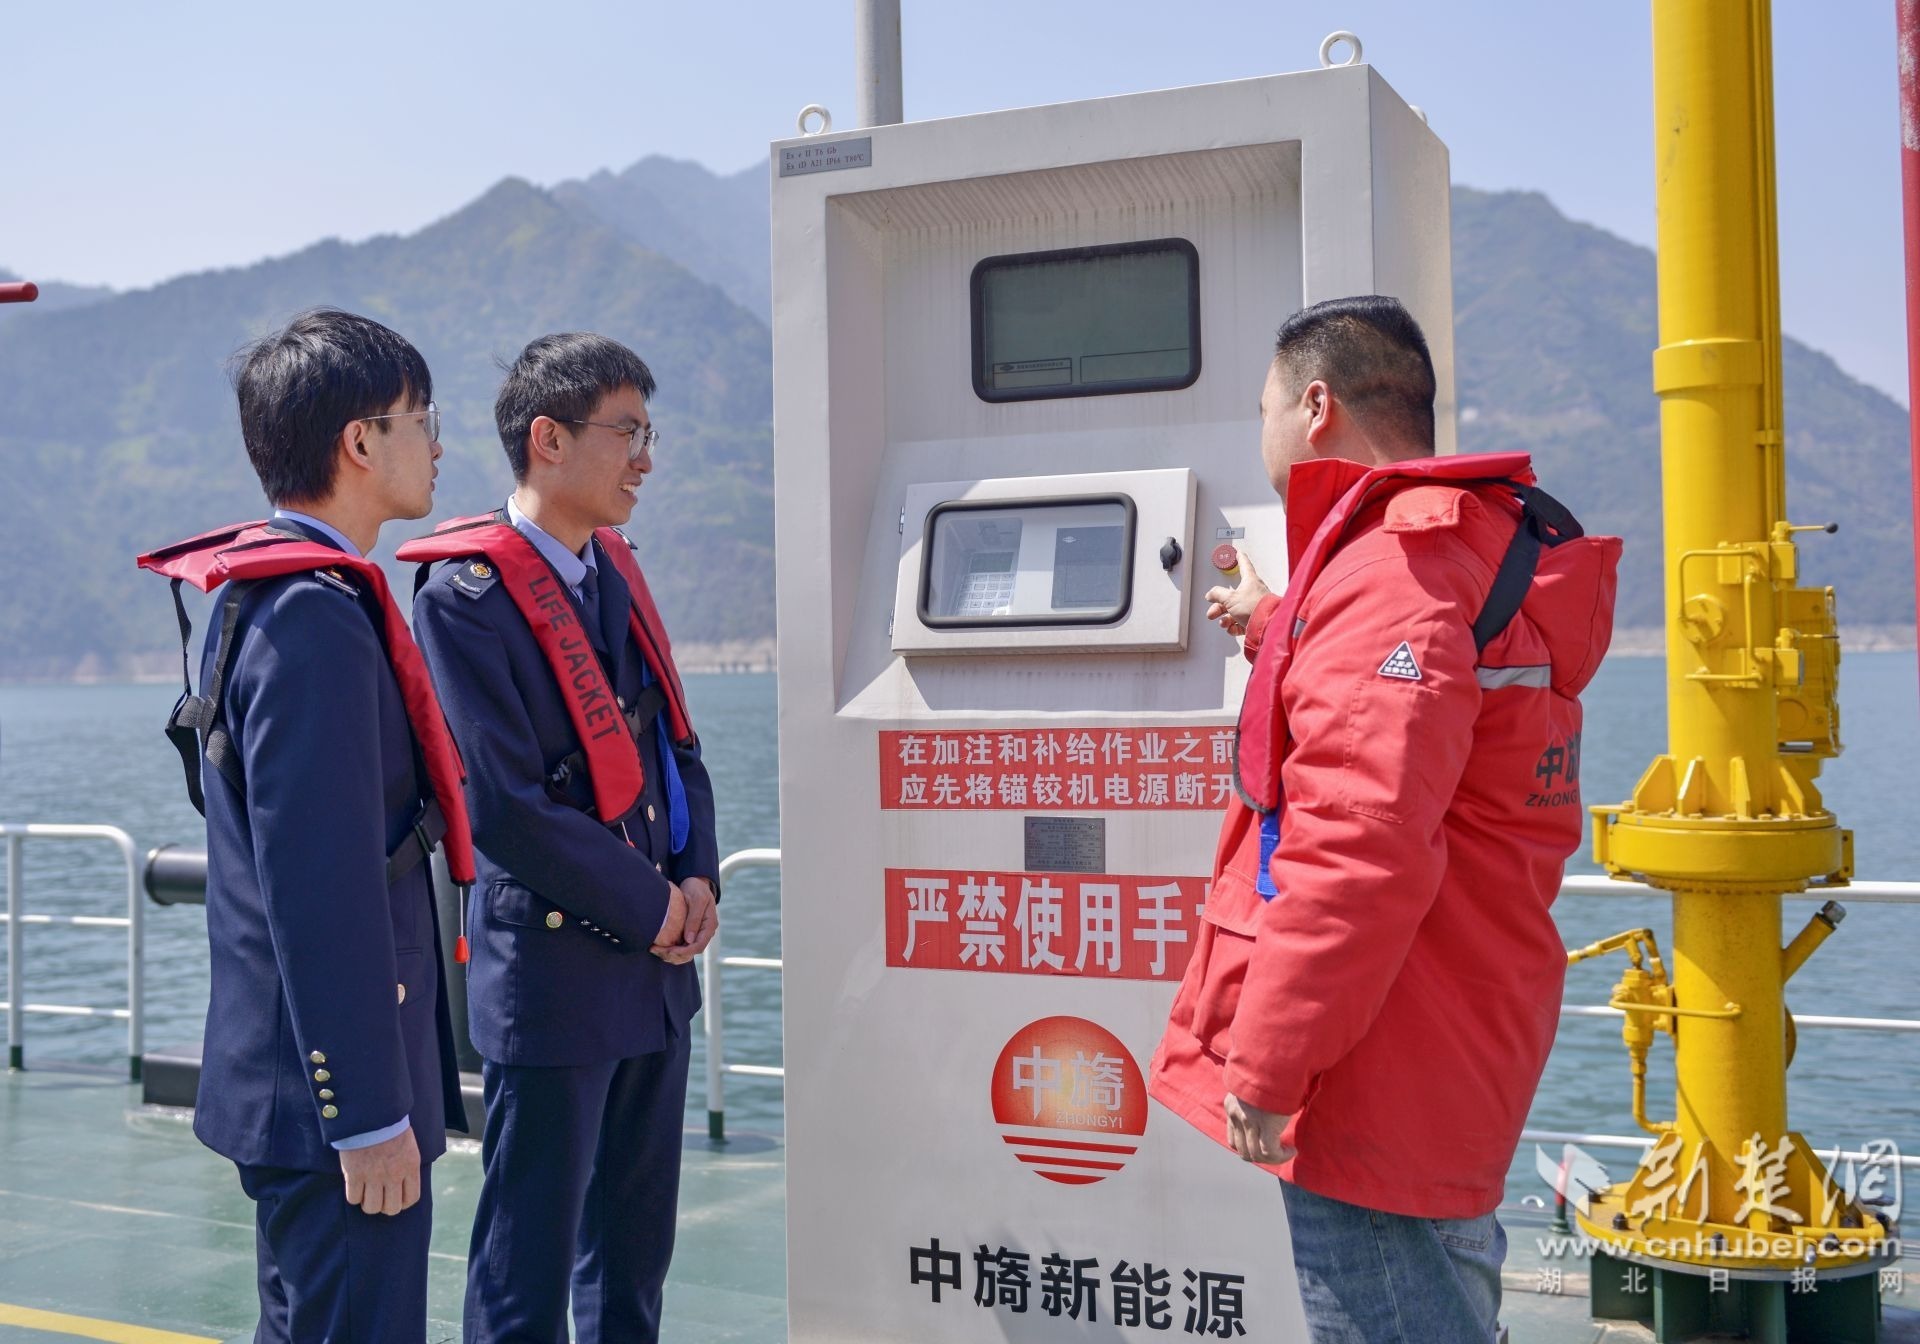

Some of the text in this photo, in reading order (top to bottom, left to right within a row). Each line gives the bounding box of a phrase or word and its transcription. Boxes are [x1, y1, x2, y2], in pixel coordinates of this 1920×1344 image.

[786, 152, 795, 160] Ex
[827, 145, 837, 155] Gb
[786, 162, 795, 170] Ex
[528, 575, 621, 741] LIFE JACKET
[898, 731, 1236, 766] 在加注和补给作业之前
[902, 876, 1207, 975] 严禁使用手
[1012, 1045, 1125, 1121] 中旖
[1055, 1111, 1123, 1129] ZHONGYI
[909, 1237, 1247, 1339] 中旖新能源
